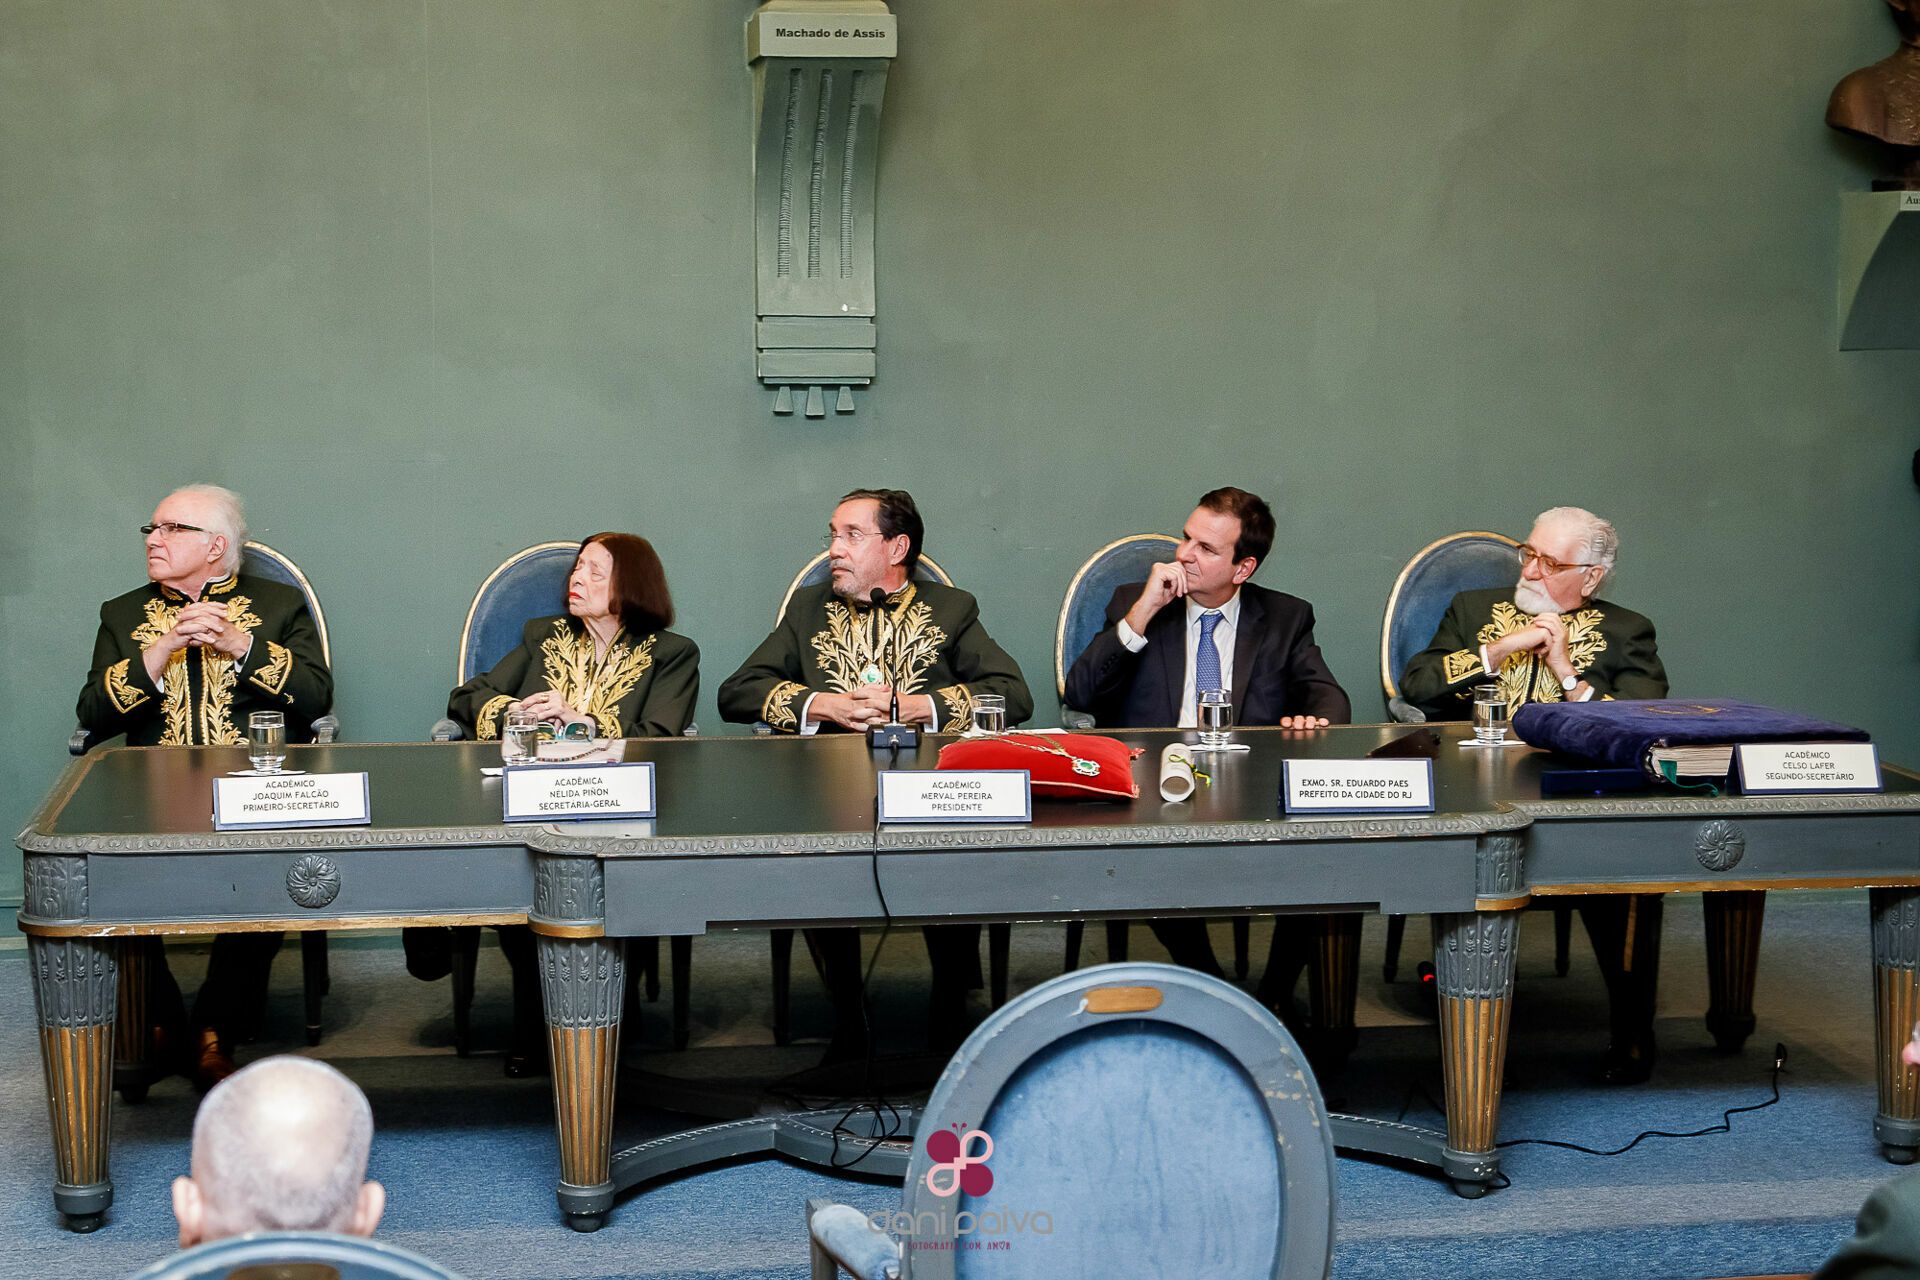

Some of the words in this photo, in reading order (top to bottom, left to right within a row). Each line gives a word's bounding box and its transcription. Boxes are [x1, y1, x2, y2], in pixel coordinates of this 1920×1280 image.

[775, 28, 831, 38] Machado
[834, 28, 850, 38] de
[852, 28, 886, 38] Assis
[1784, 750, 1831, 759] ACADÊMICO
[1782, 762, 1808, 770] CELSO
[1809, 762, 1836, 770] LAFER
[265, 779, 316, 789] ACADÊMICO
[554, 776, 604, 786] ACADÊMICA
[932, 780, 981, 789] ACADÊMICO
[1301, 779, 1328, 787] EXMO.
[1330, 779, 1344, 787] SR.
[1346, 779, 1386, 788] EDUARDO
[1388, 779, 1409, 788] PAES
[252, 791, 293, 801] JOAQUIM
[295, 789, 329, 799] FALCÃO
[582, 787, 609, 797] PIÑON
[920, 792, 955, 800] MERVAL
[957, 792, 993, 800] PEREIRA
[1299, 790, 1339, 798] PREFEITO
[1341, 790, 1353, 798] DA
[1355, 790, 1385, 799] CIDADE
[1387, 791, 1400, 799] DO
[1402, 791, 1412, 799] RJ
[931, 803, 983, 811] PRESIDENTE
